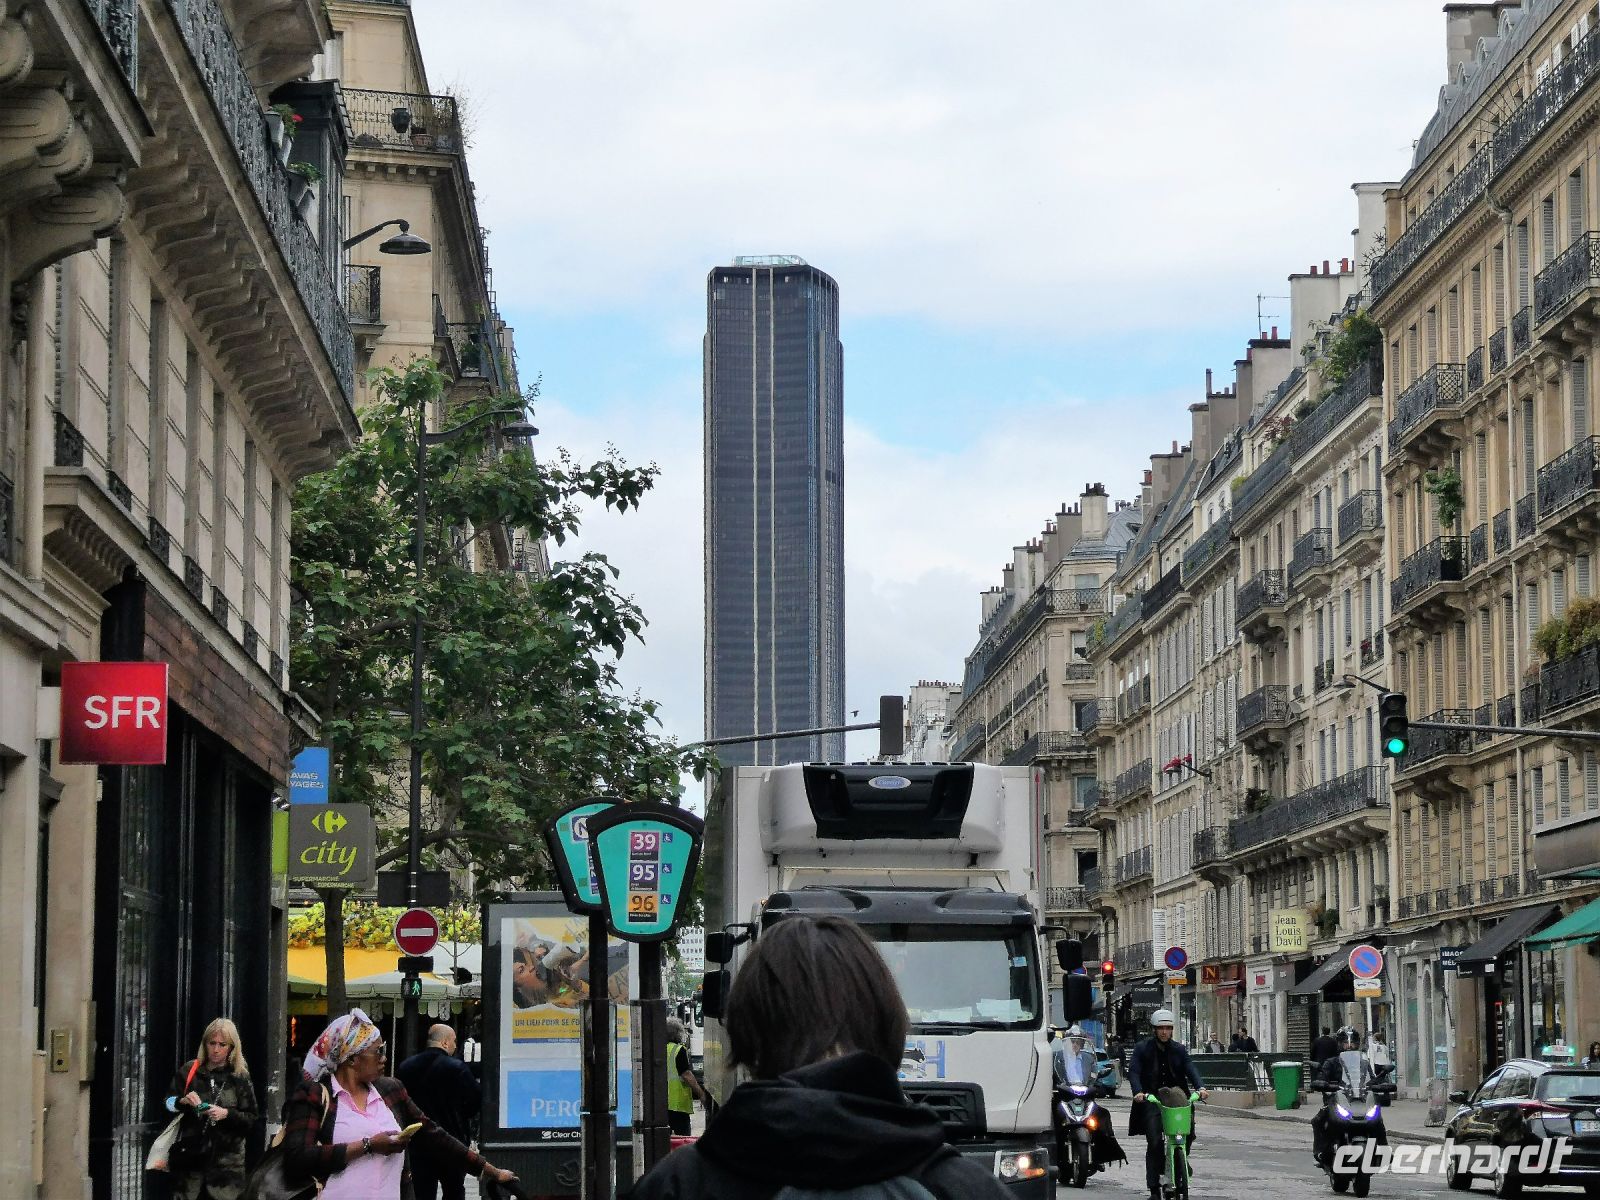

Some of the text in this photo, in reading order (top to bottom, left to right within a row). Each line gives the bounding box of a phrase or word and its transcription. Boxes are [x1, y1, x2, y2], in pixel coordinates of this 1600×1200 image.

[84, 695, 161, 729] SFR
[290, 772, 319, 780] AVAS
[289, 780, 324, 789] YAGES
[633, 833, 656, 850] 39
[300, 841, 357, 876] city
[632, 864, 655, 881] 95
[631, 895, 654, 912] 96
[1275, 914, 1297, 925] Jean
[1275, 925, 1301, 936] Louis
[1275, 936, 1302, 947] David
[1205, 966, 1216, 979] N
[561, 1018, 570, 1026] SE
[552, 1130, 570, 1138] Clear
